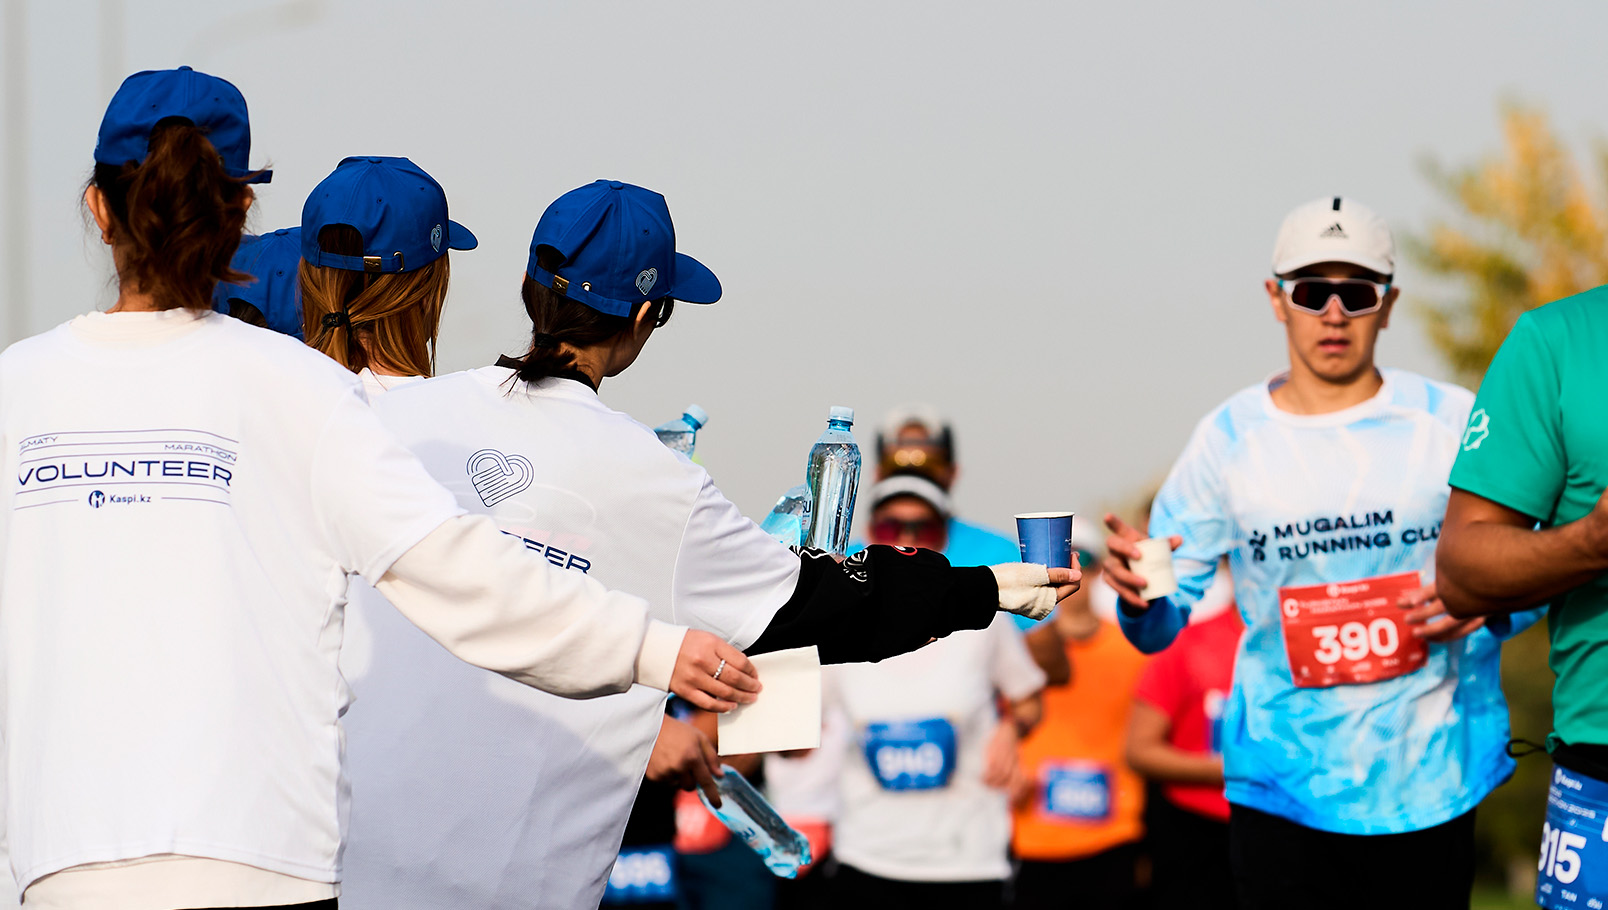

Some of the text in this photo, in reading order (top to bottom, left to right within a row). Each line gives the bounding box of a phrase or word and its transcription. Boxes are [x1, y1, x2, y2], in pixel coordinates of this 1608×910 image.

[164, 444, 238, 462] MARATHON
[18, 461, 233, 486] VOLUNTEER
[109, 494, 152, 505] Kaspi.kz
[1274, 510, 1394, 539] MUGALIM
[1278, 532, 1392, 561] RUNNING
[1312, 617, 1400, 665] 390
[1538, 821, 1588, 884] 915
